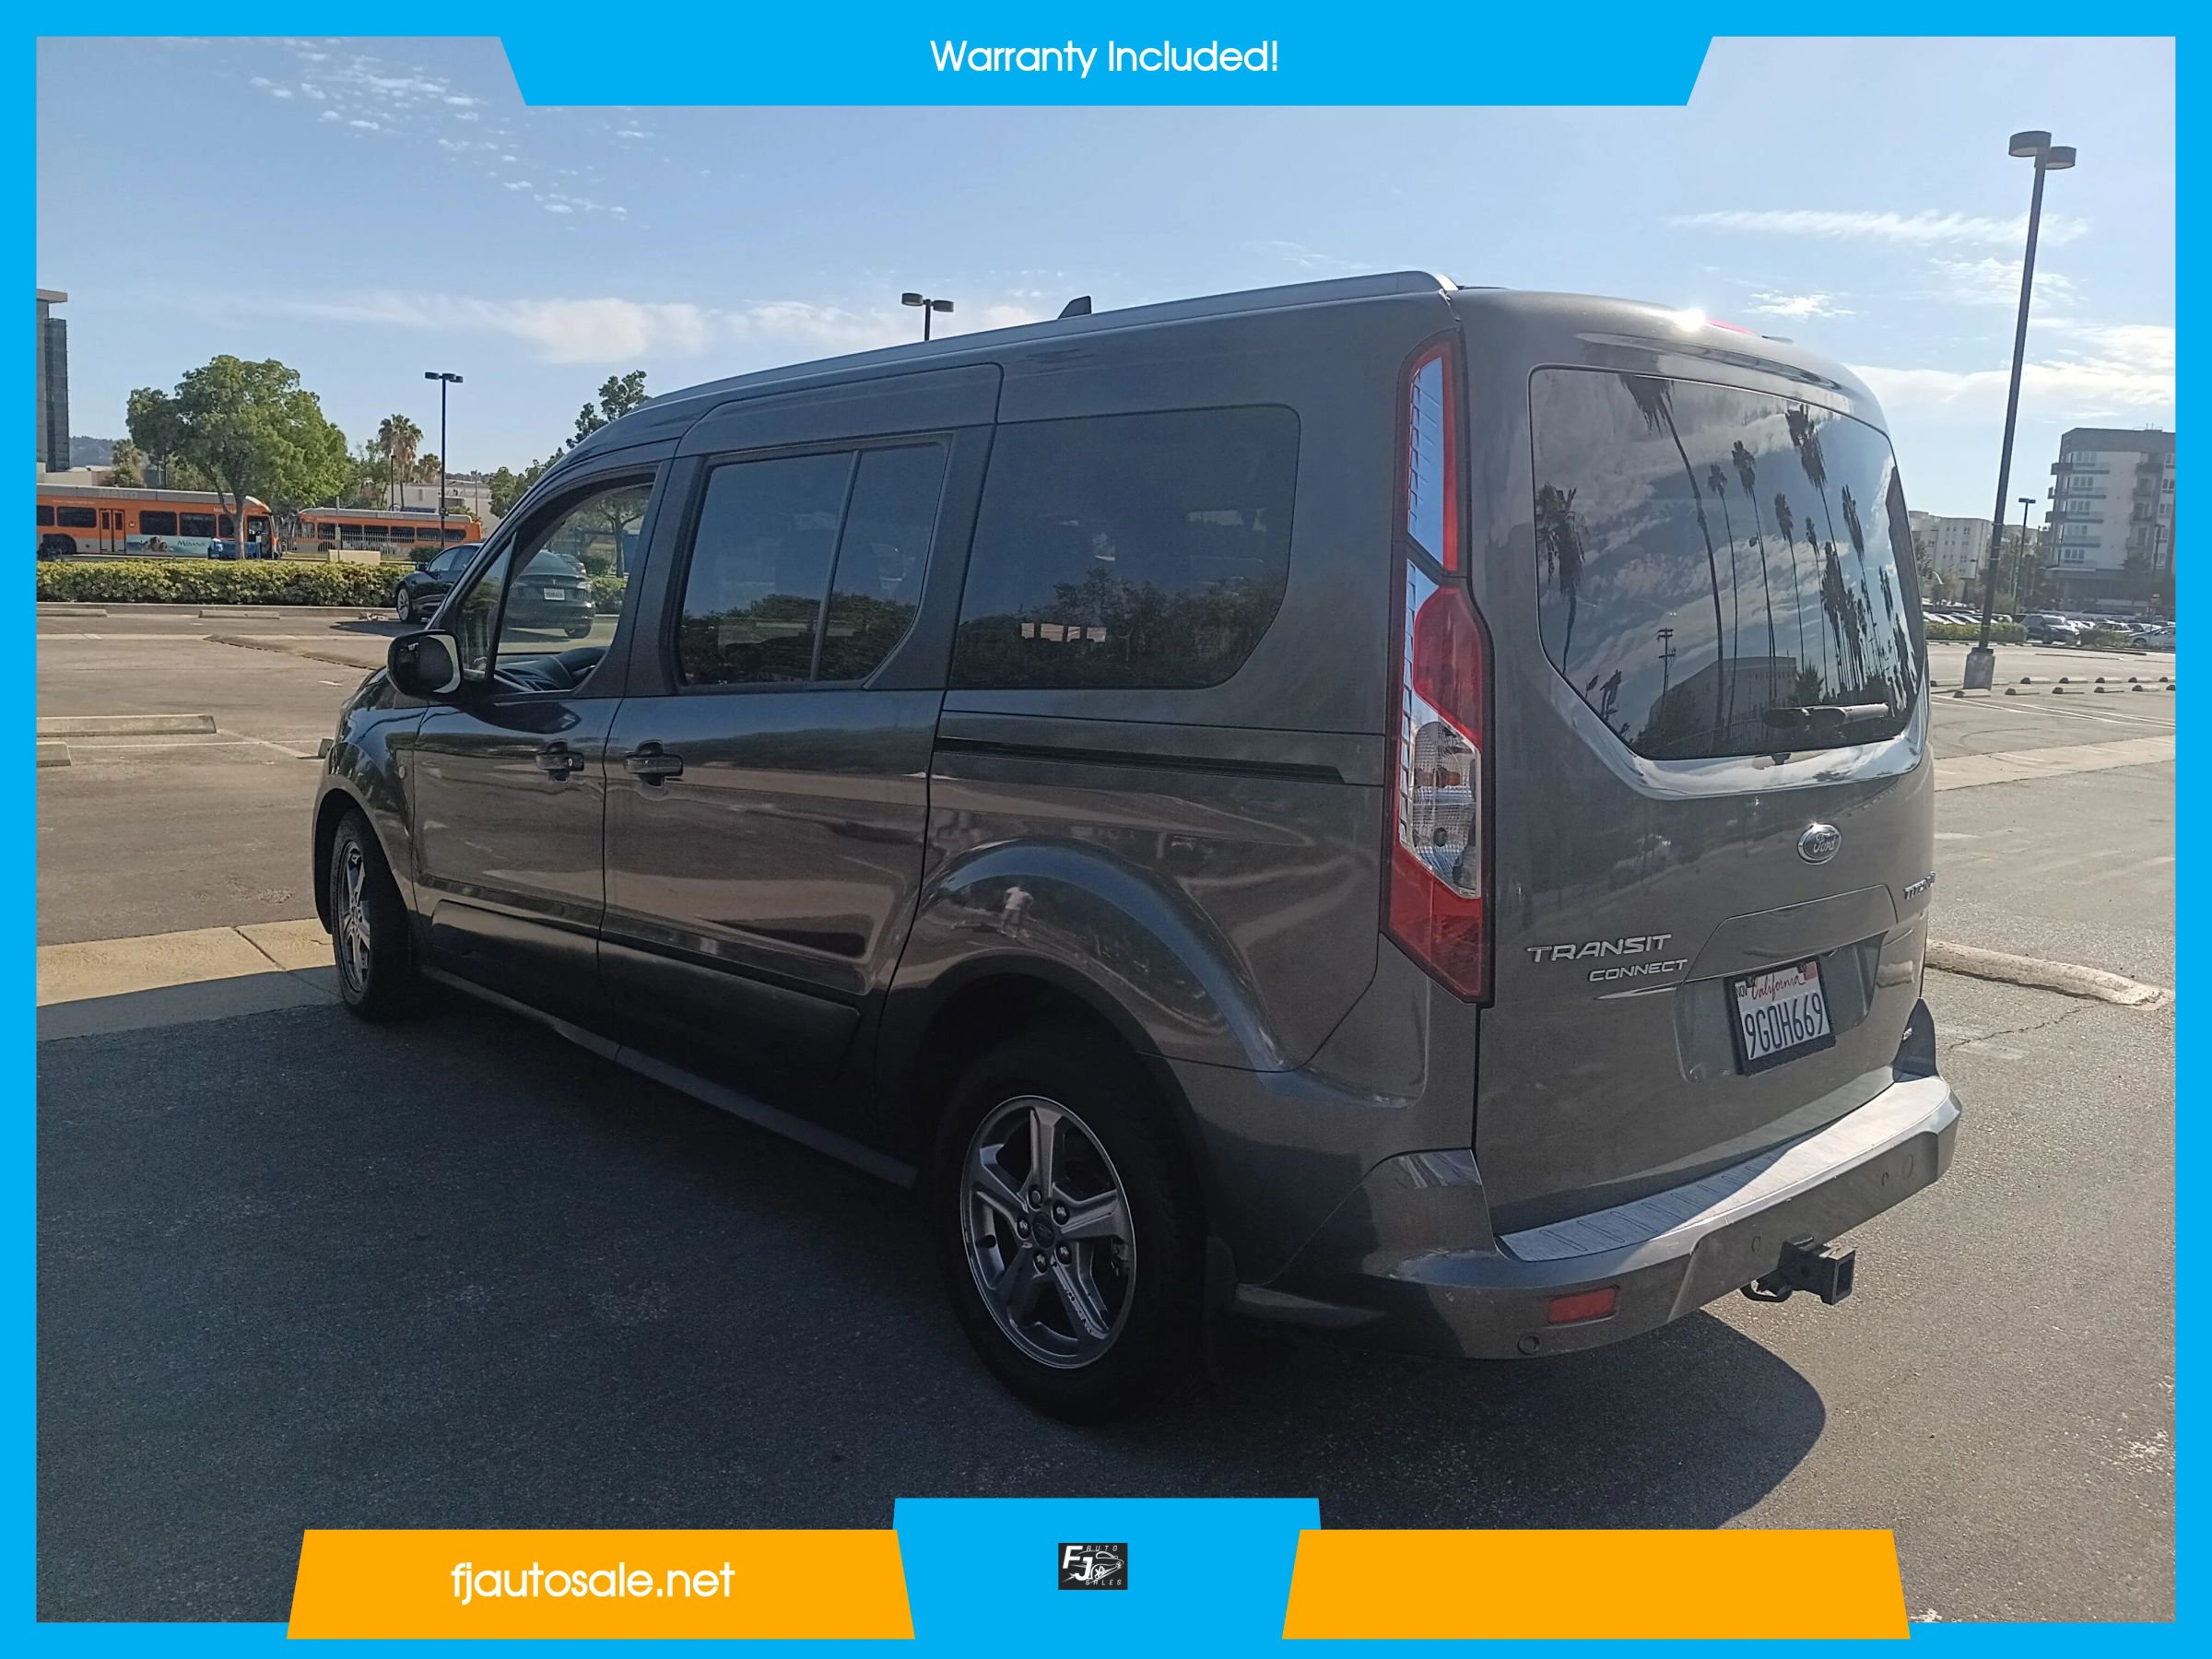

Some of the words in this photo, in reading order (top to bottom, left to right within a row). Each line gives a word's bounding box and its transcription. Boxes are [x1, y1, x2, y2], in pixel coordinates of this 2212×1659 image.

[1812, 832, 1839, 853] Ford
[1526, 934, 1672, 963] TRANSIT
[1588, 959, 1688, 982] CONNECT
[1751, 972, 1806, 1002] California
